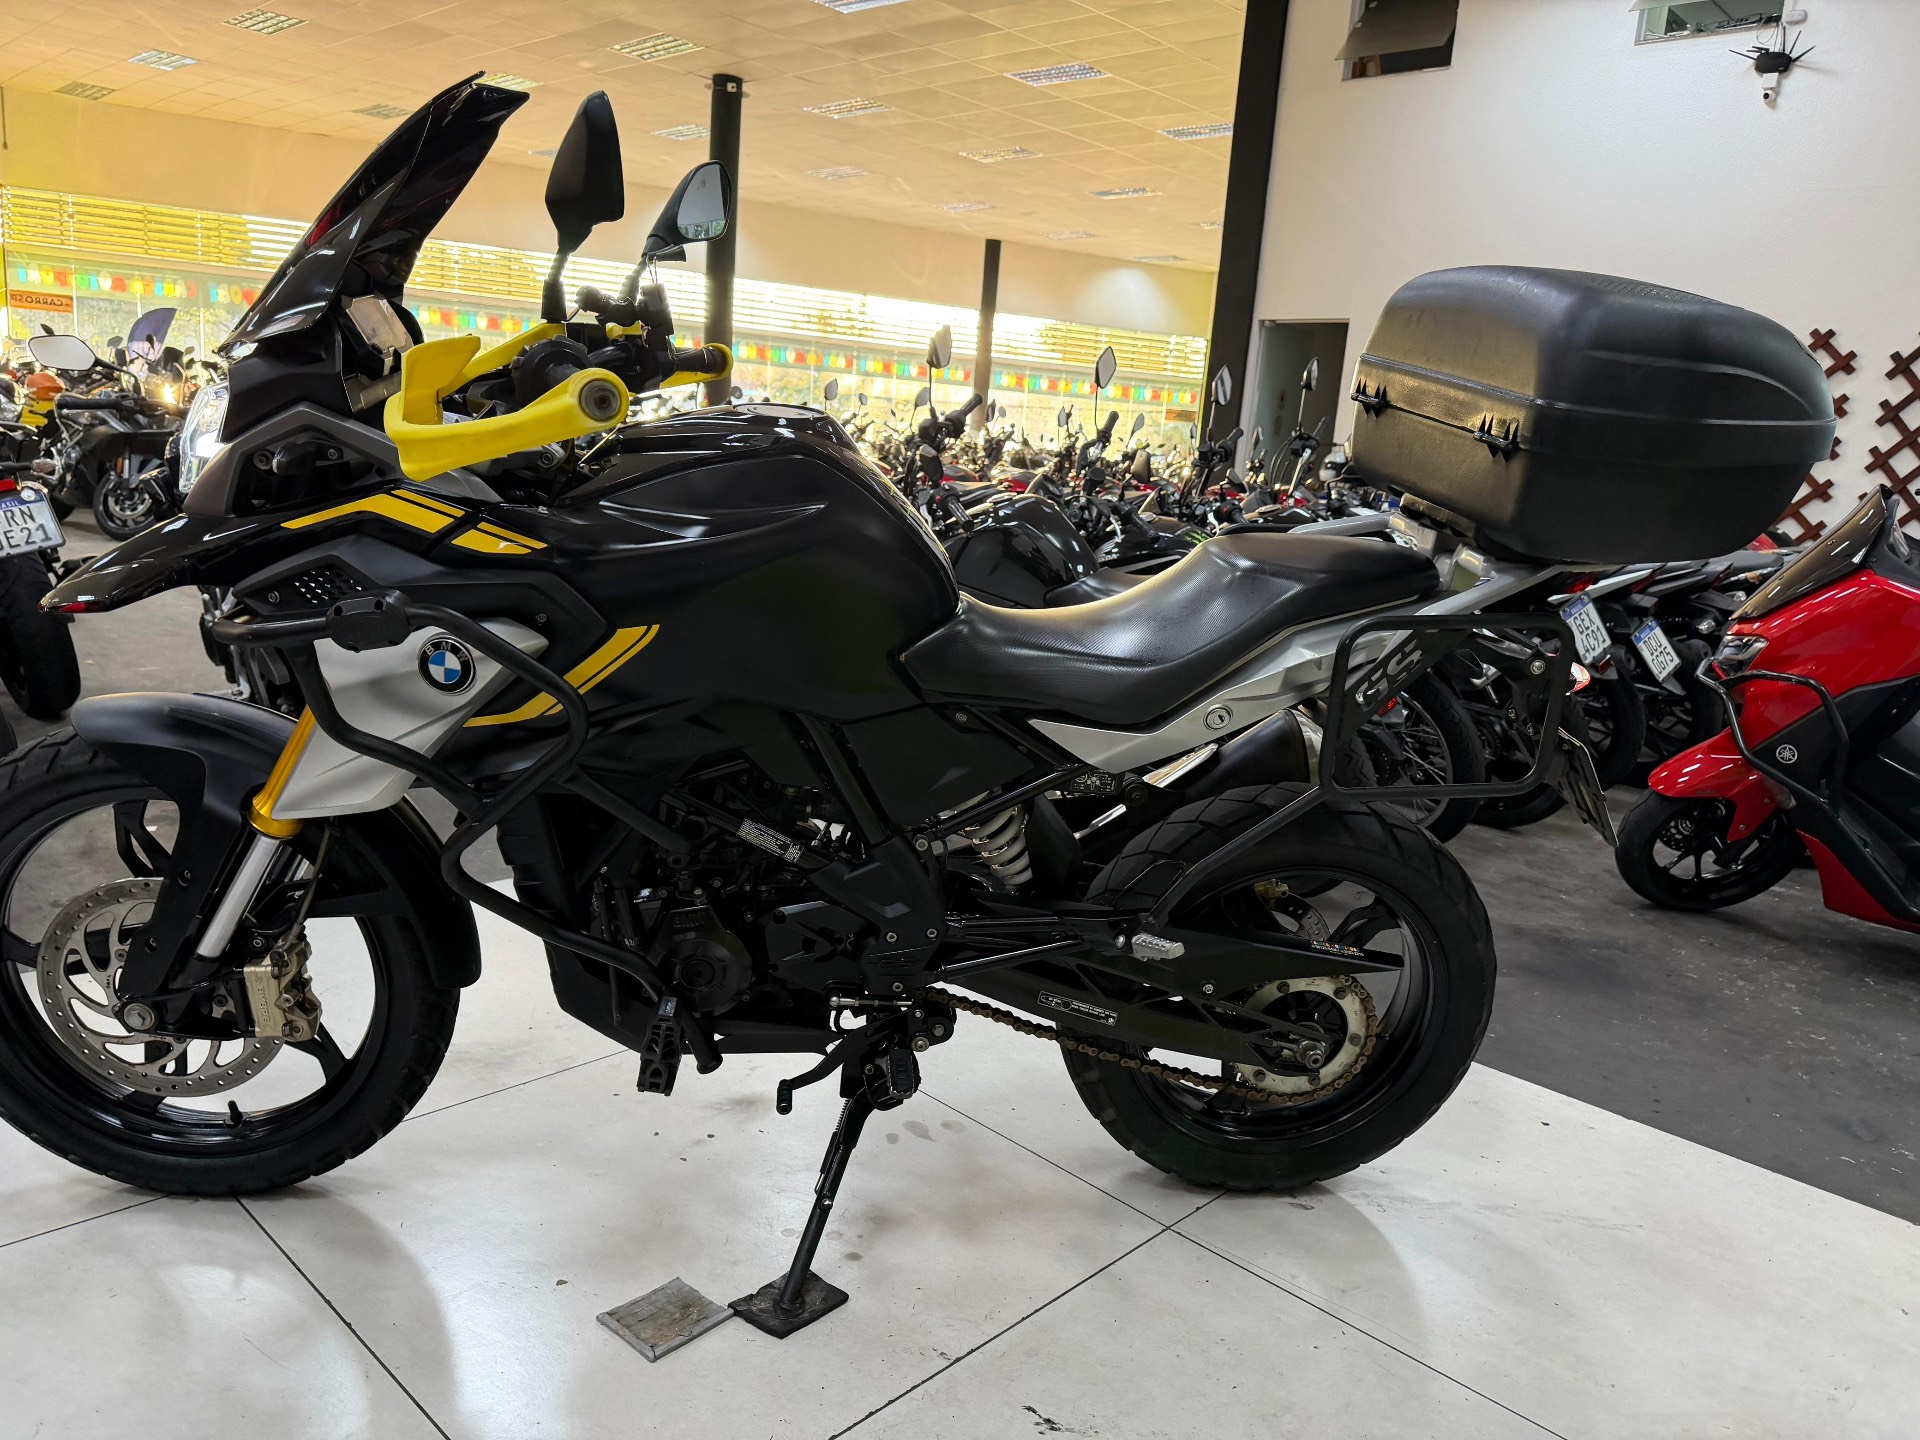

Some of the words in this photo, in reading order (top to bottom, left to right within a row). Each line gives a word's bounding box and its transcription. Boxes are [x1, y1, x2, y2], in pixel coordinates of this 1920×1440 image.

[0, 500, 20, 509] ASIL
[1, 505, 36, 527] RN
[1573, 608, 1595, 635] GEX
[425, 641, 469, 662] BMW
